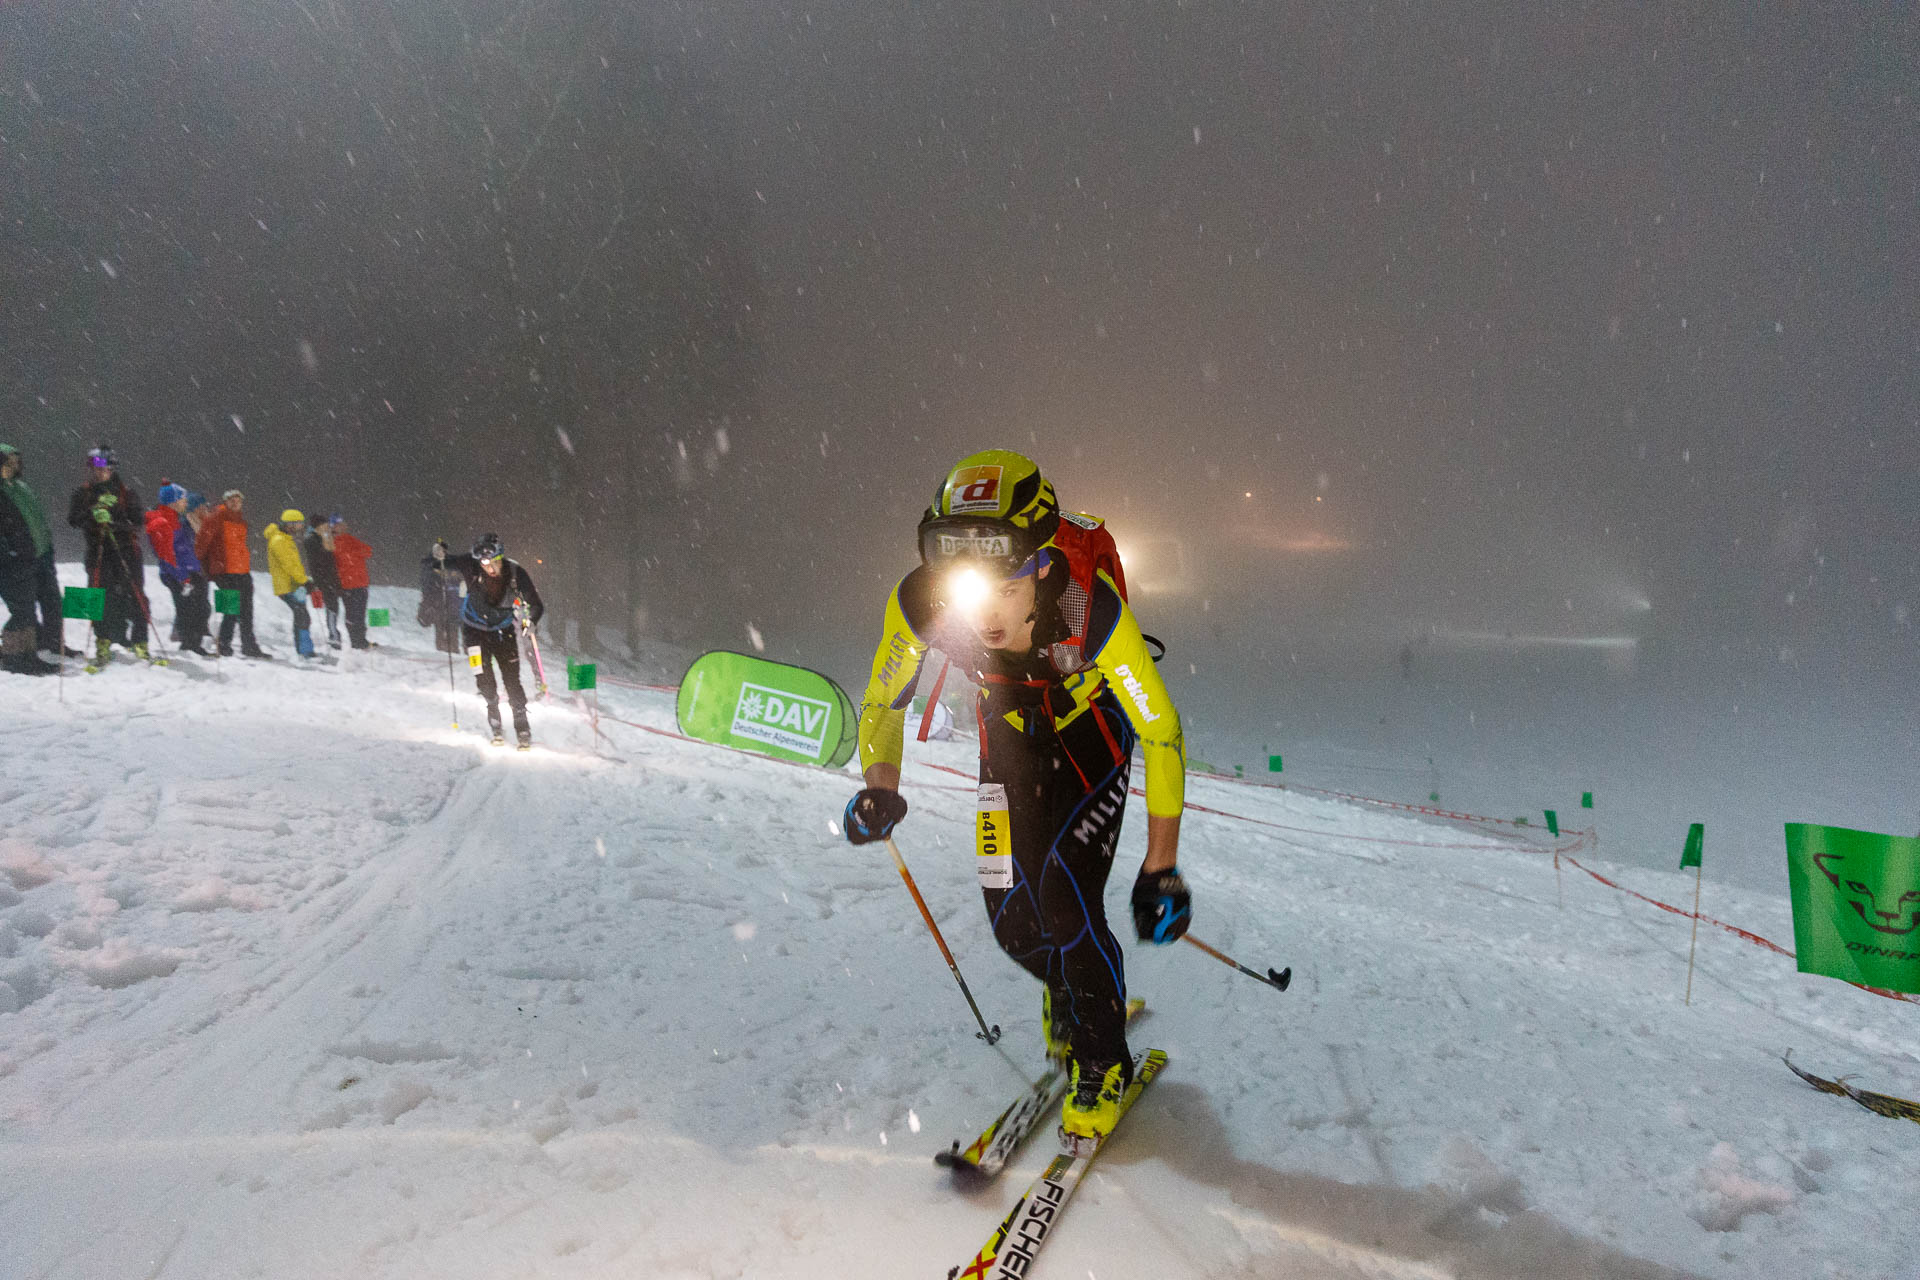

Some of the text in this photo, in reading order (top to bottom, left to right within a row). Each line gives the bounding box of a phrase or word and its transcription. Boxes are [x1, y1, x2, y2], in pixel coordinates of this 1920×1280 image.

[878, 632, 910, 687] MILLET
[763, 696, 824, 734] DAV
[734, 720, 820, 754] Deutscher Alpenverein
